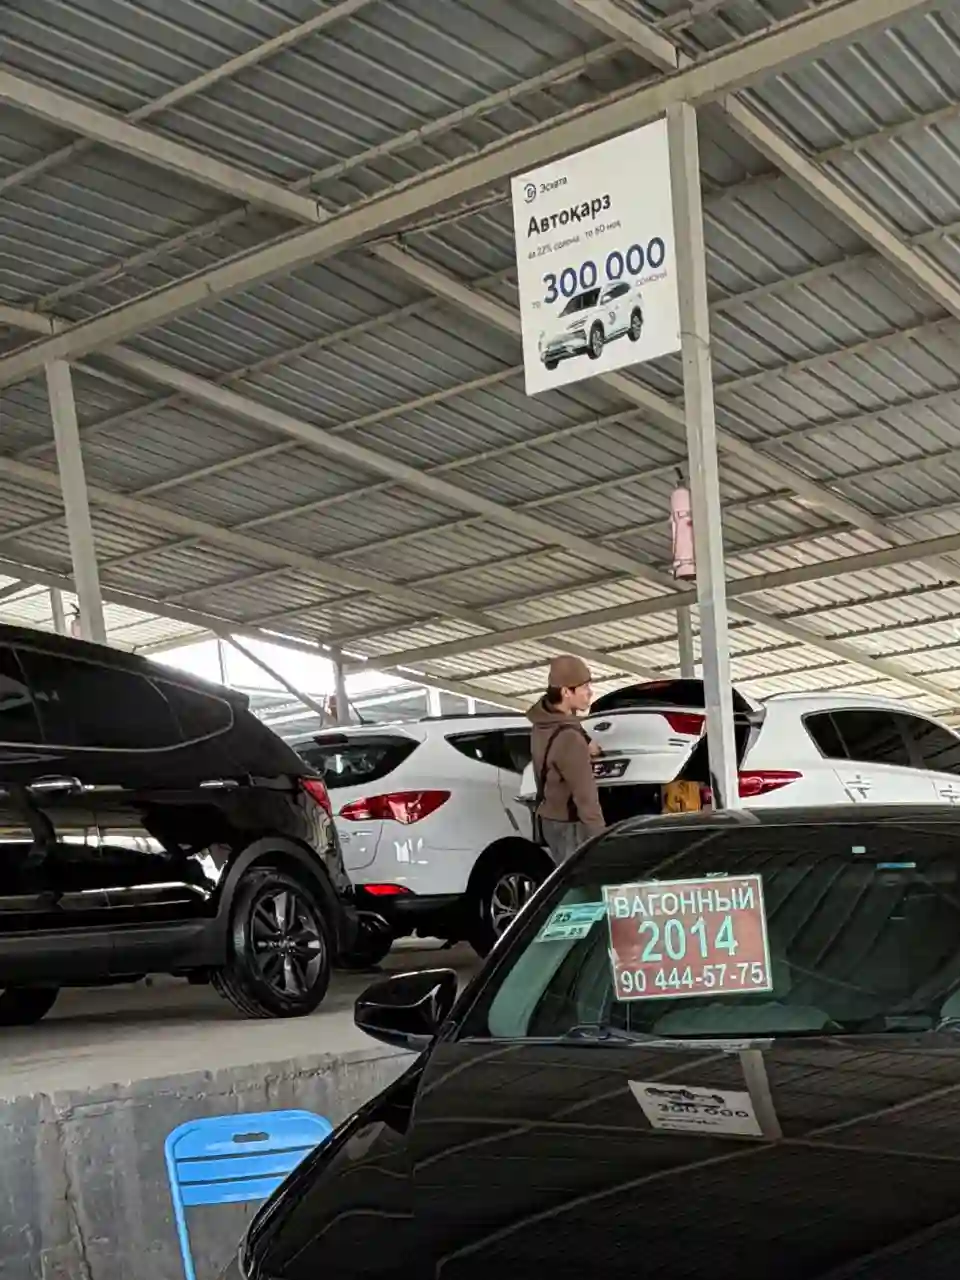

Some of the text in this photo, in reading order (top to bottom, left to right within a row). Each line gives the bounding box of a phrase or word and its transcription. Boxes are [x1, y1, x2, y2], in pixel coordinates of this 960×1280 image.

[527, 193, 612, 238] Автоқарз
[542, 261, 597, 304] 300
[605, 237, 665, 280] 000
[613, 882, 755, 919] ВАГОННЫЙ
[638, 915, 738, 962] 2014
[620, 962, 765, 993] 90 444-57-75
